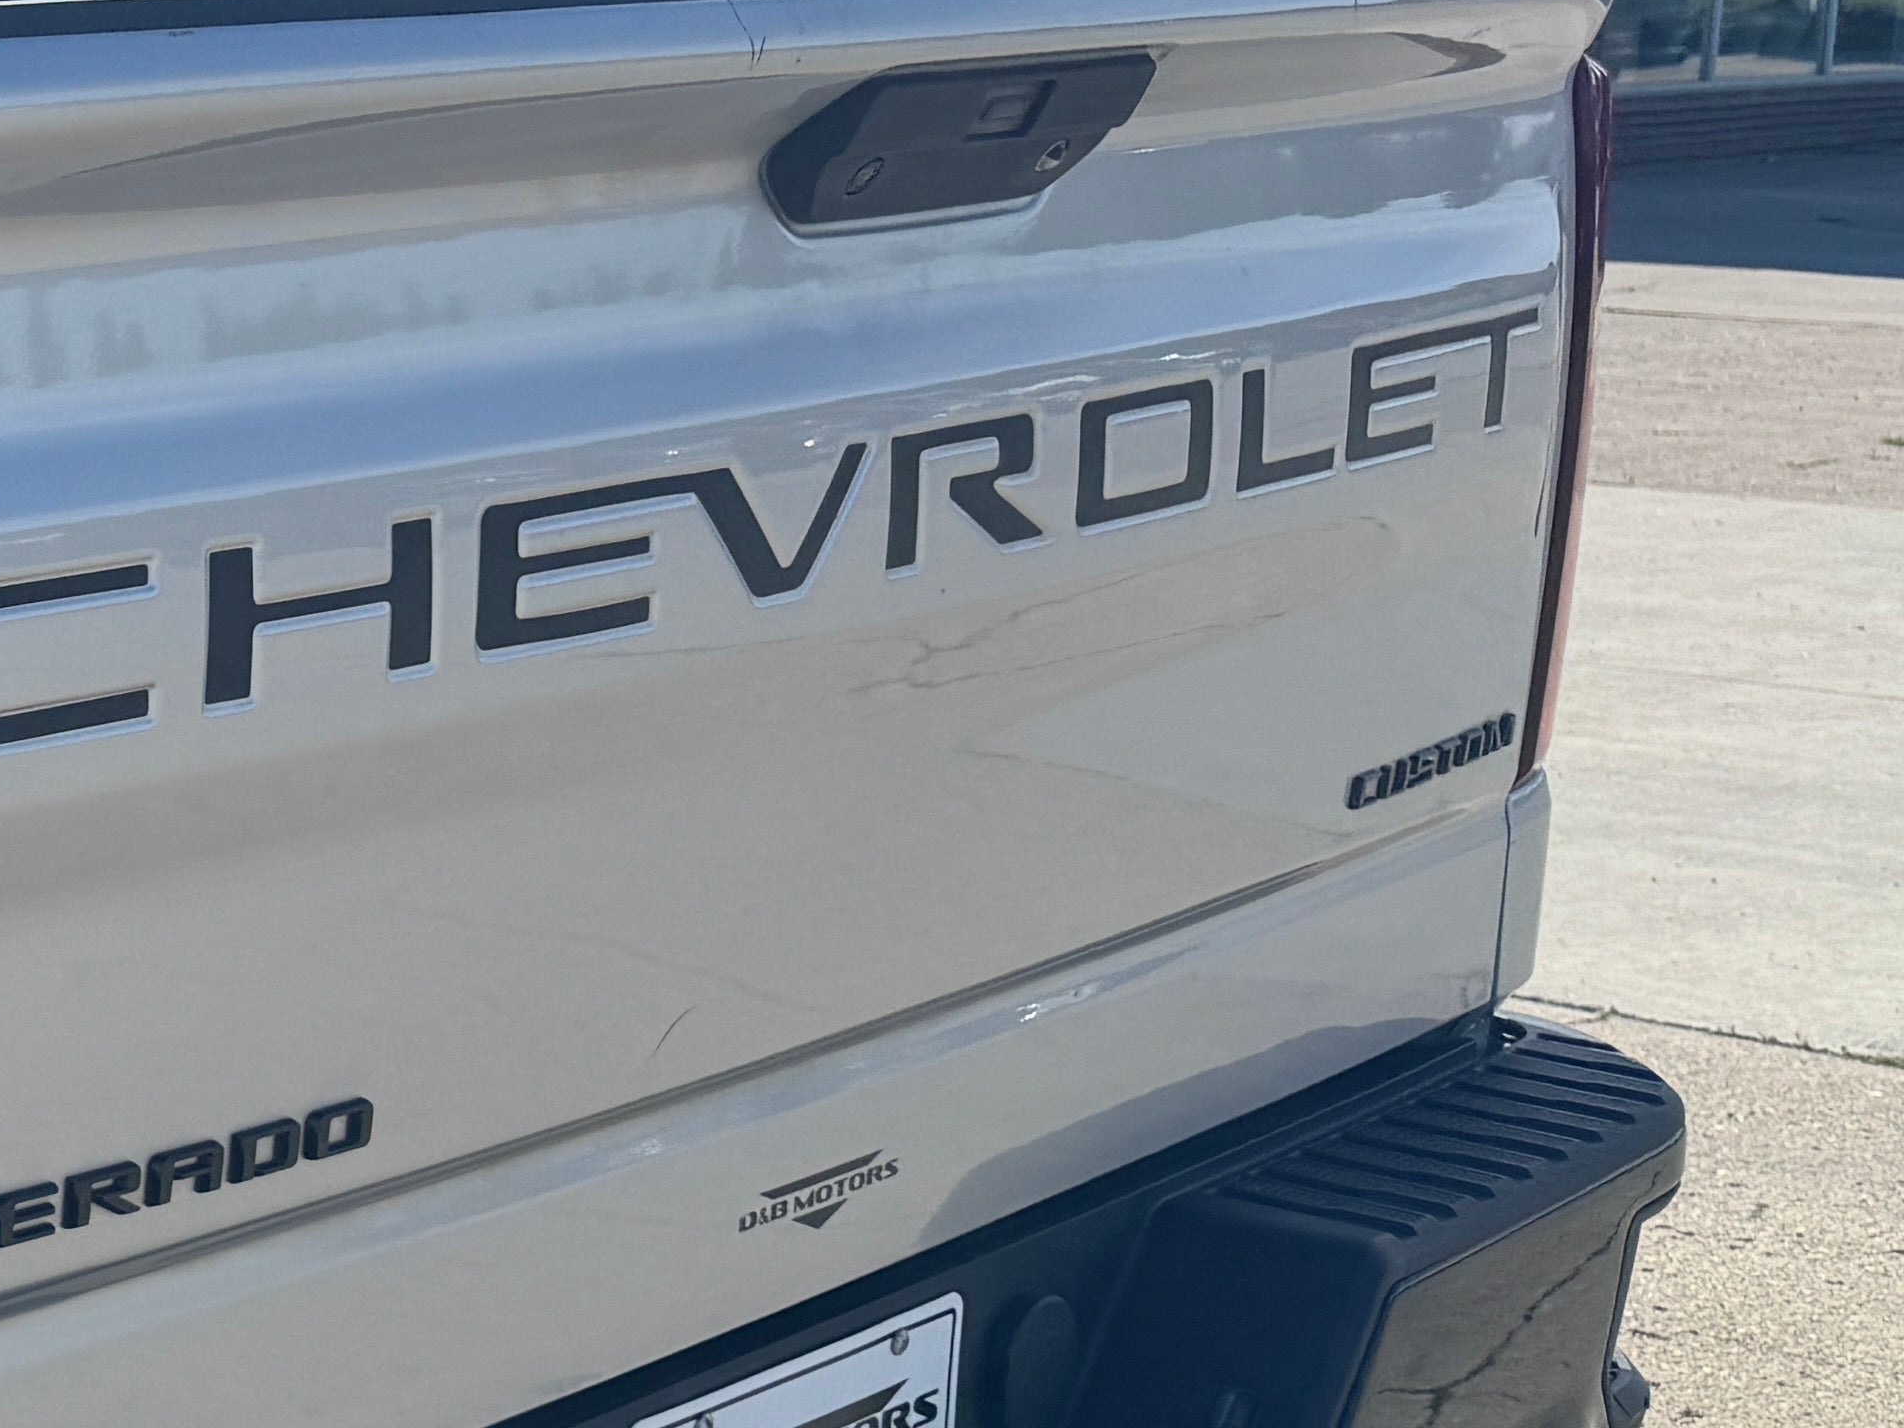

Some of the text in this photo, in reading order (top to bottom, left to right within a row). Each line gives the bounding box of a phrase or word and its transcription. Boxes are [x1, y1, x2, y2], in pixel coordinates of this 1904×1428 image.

[1344, 712, 1516, 809] CUSTOM
[738, 1158, 899, 1232] D&B MOTORS
